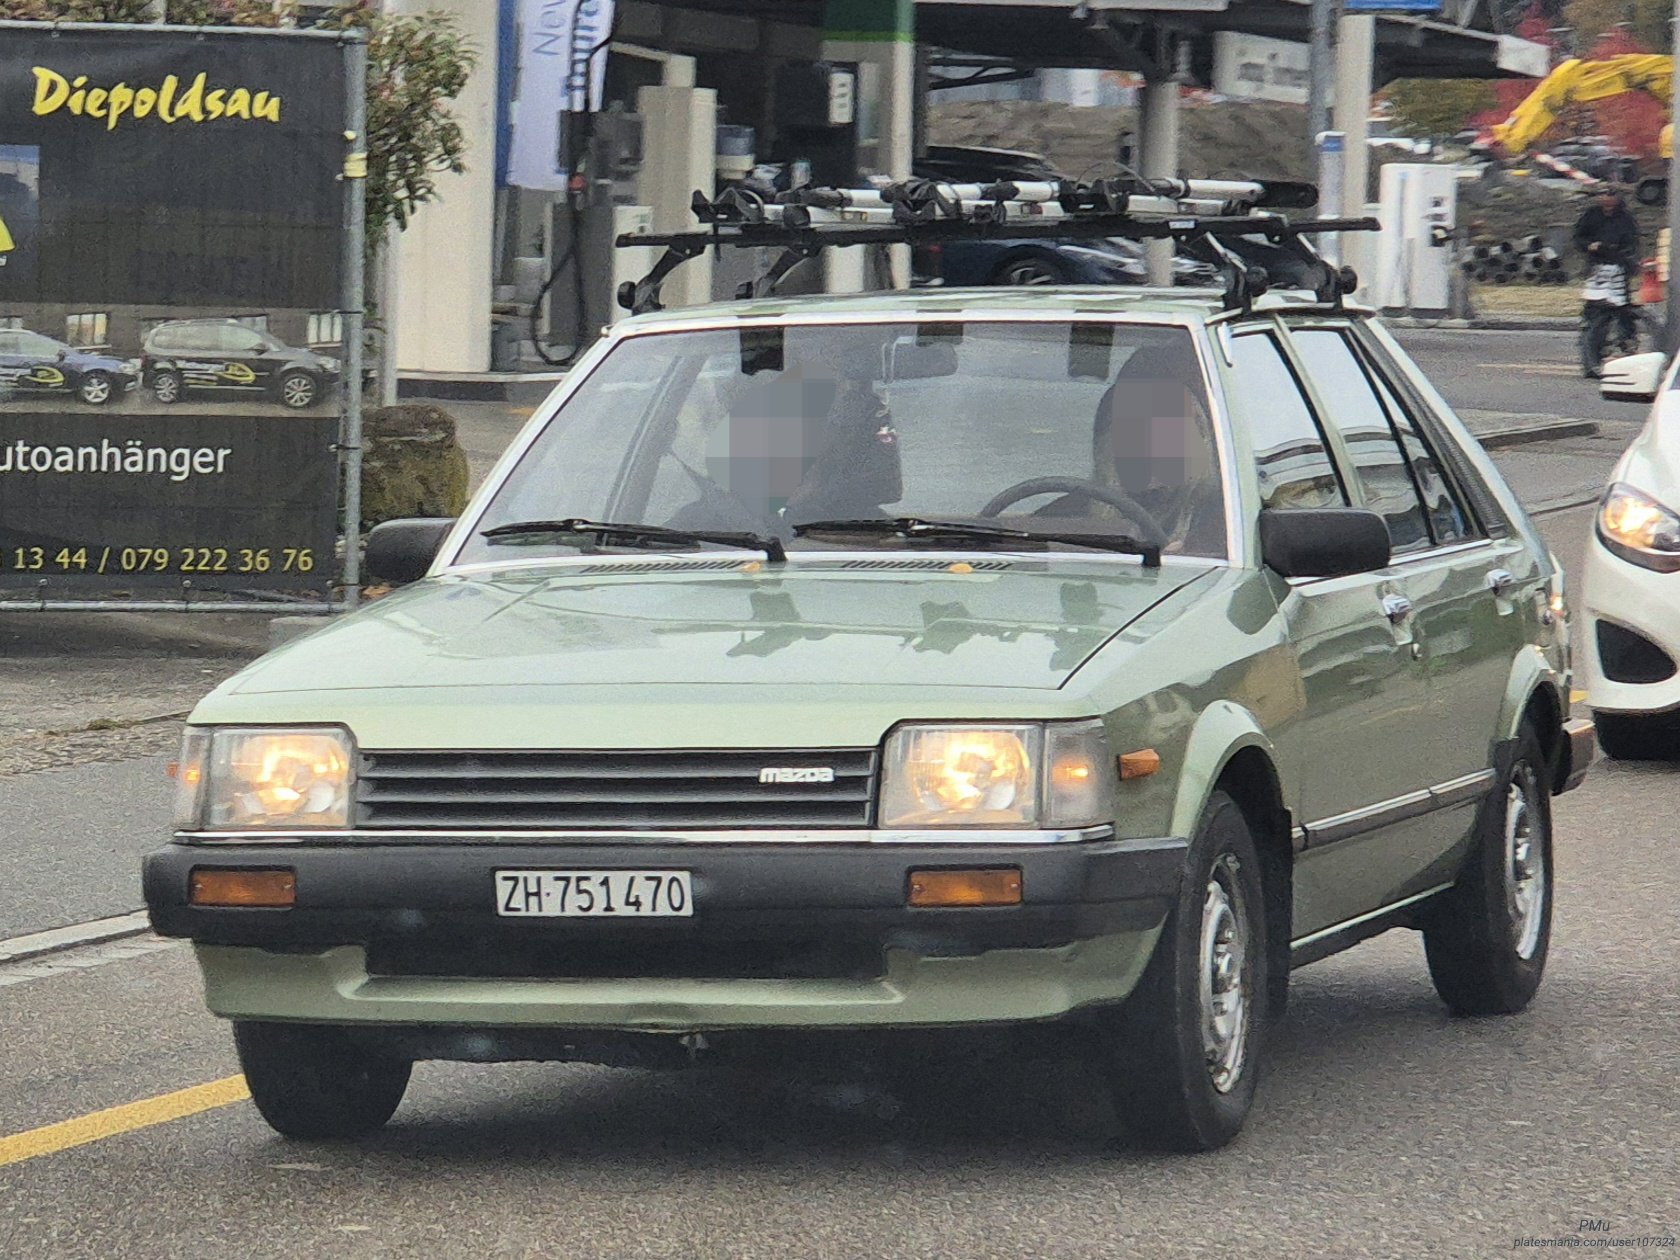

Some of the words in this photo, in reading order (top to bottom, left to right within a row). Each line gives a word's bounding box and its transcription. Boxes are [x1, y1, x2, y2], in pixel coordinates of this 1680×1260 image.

[31, 66, 281, 131] Diepoldsau
[0, 439, 232, 482] utoanhänger
[14, 547, 44, 569] 13
[55, 548, 88, 570] 44
[98, 547, 110, 573] /
[121, 548, 169, 571] 079
[180, 548, 228, 571] 222
[239, 549, 270, 571] 36
[282, 549, 314, 571] 76
